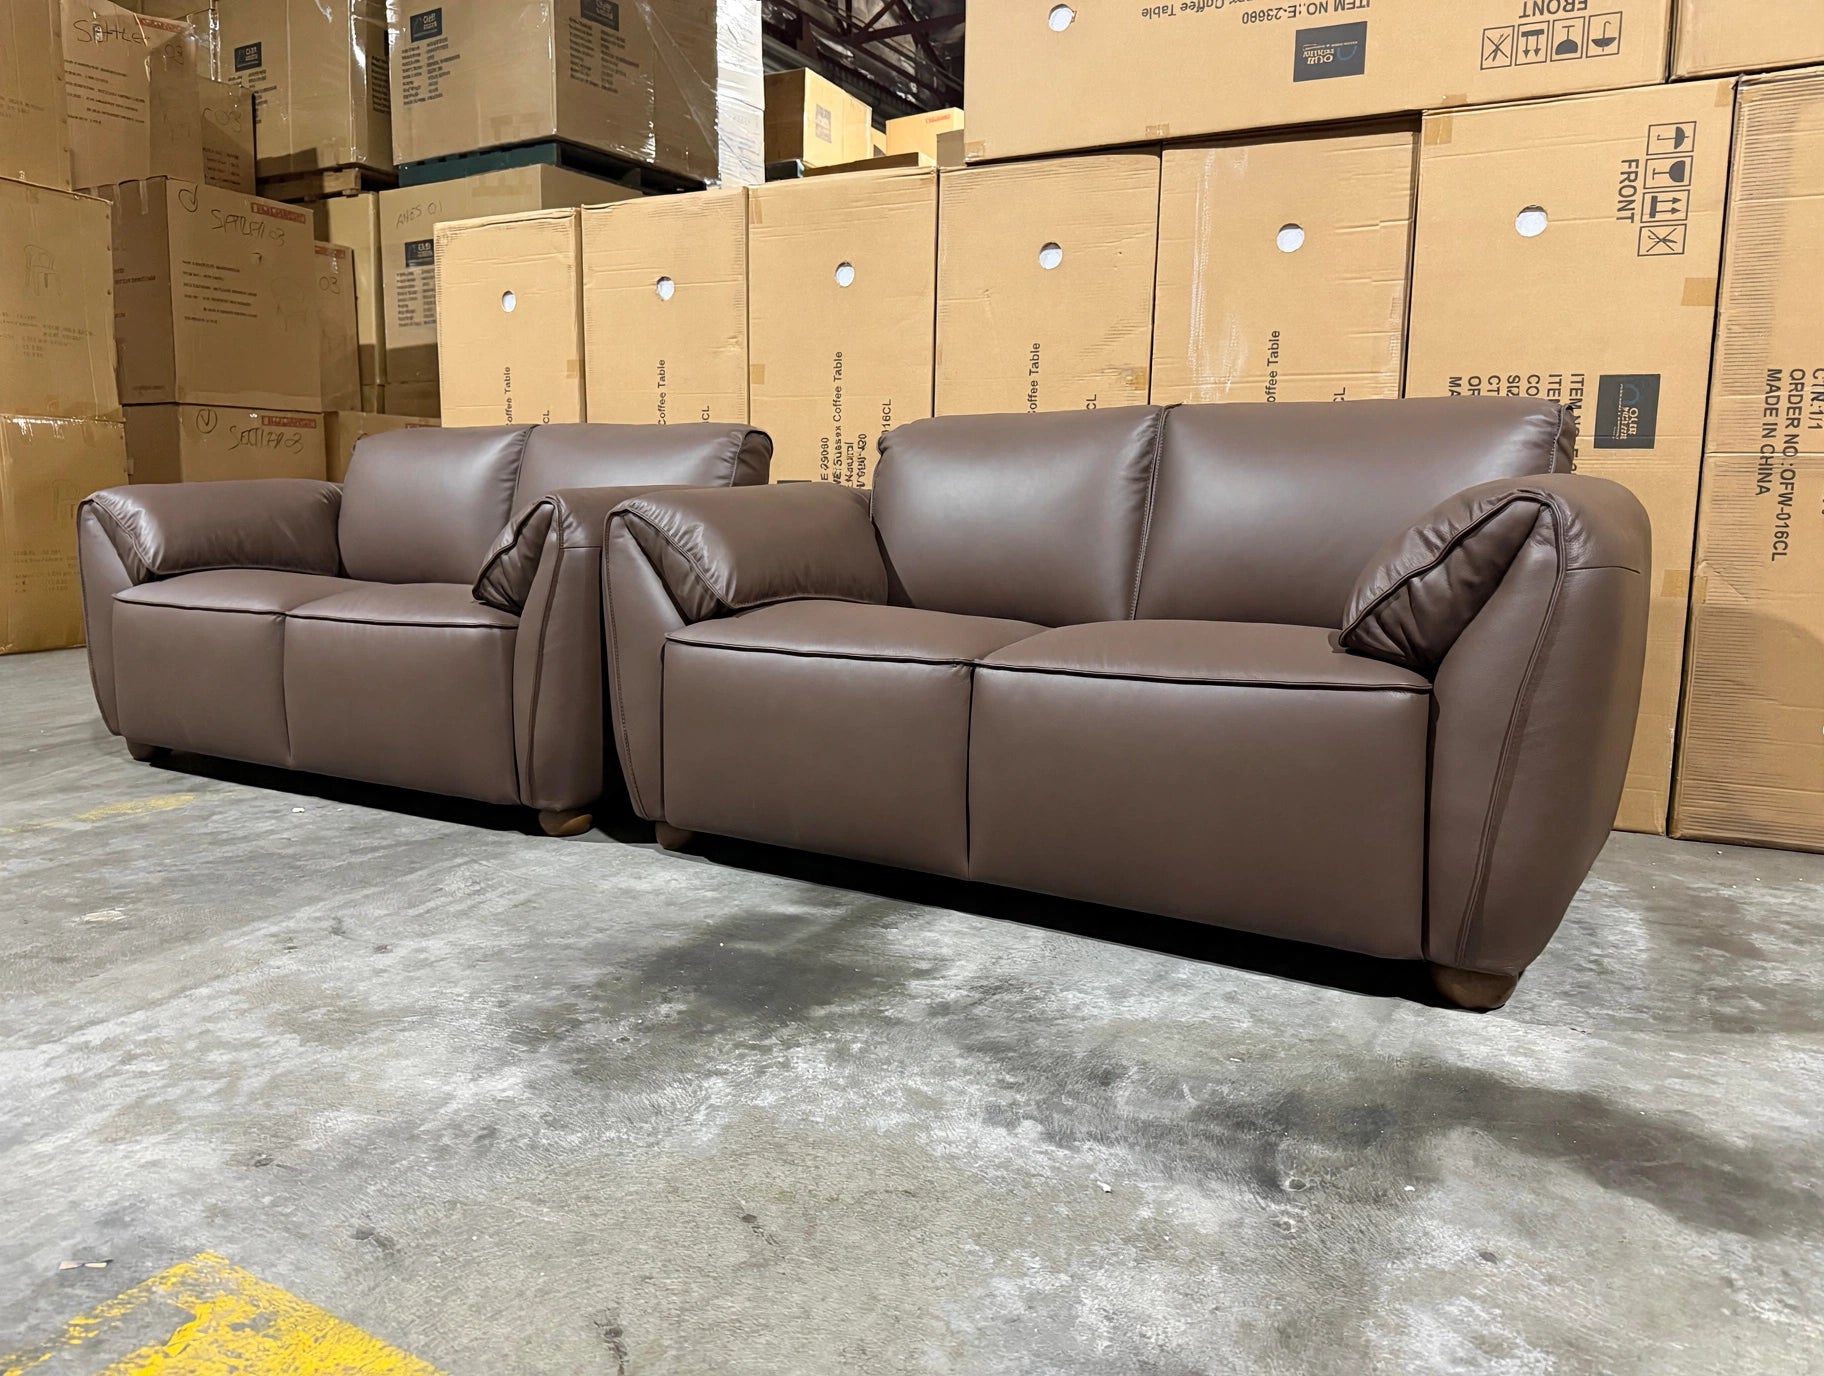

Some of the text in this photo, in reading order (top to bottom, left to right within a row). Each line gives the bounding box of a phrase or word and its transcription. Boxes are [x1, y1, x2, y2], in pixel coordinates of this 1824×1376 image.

[1141, 4, 1177, 19] Table
[1334, 0, 1370, 12] ITEM
[1518, 0, 1588, 19] FRONT
[1616, 158, 1639, 224] FRONT
[833, 351, 843, 382] Table
[1266, 330, 1281, 367] Table
[657, 359, 666, 388] Table
[1027, 343, 1040, 413] offee Table
[1568, 373, 1585, 409] ITEM
[832, 386, 842, 422] Coffee
[1784, 368, 1806, 429] ORDER
[1755, 368, 1783, 496] MADE IN CHINA
